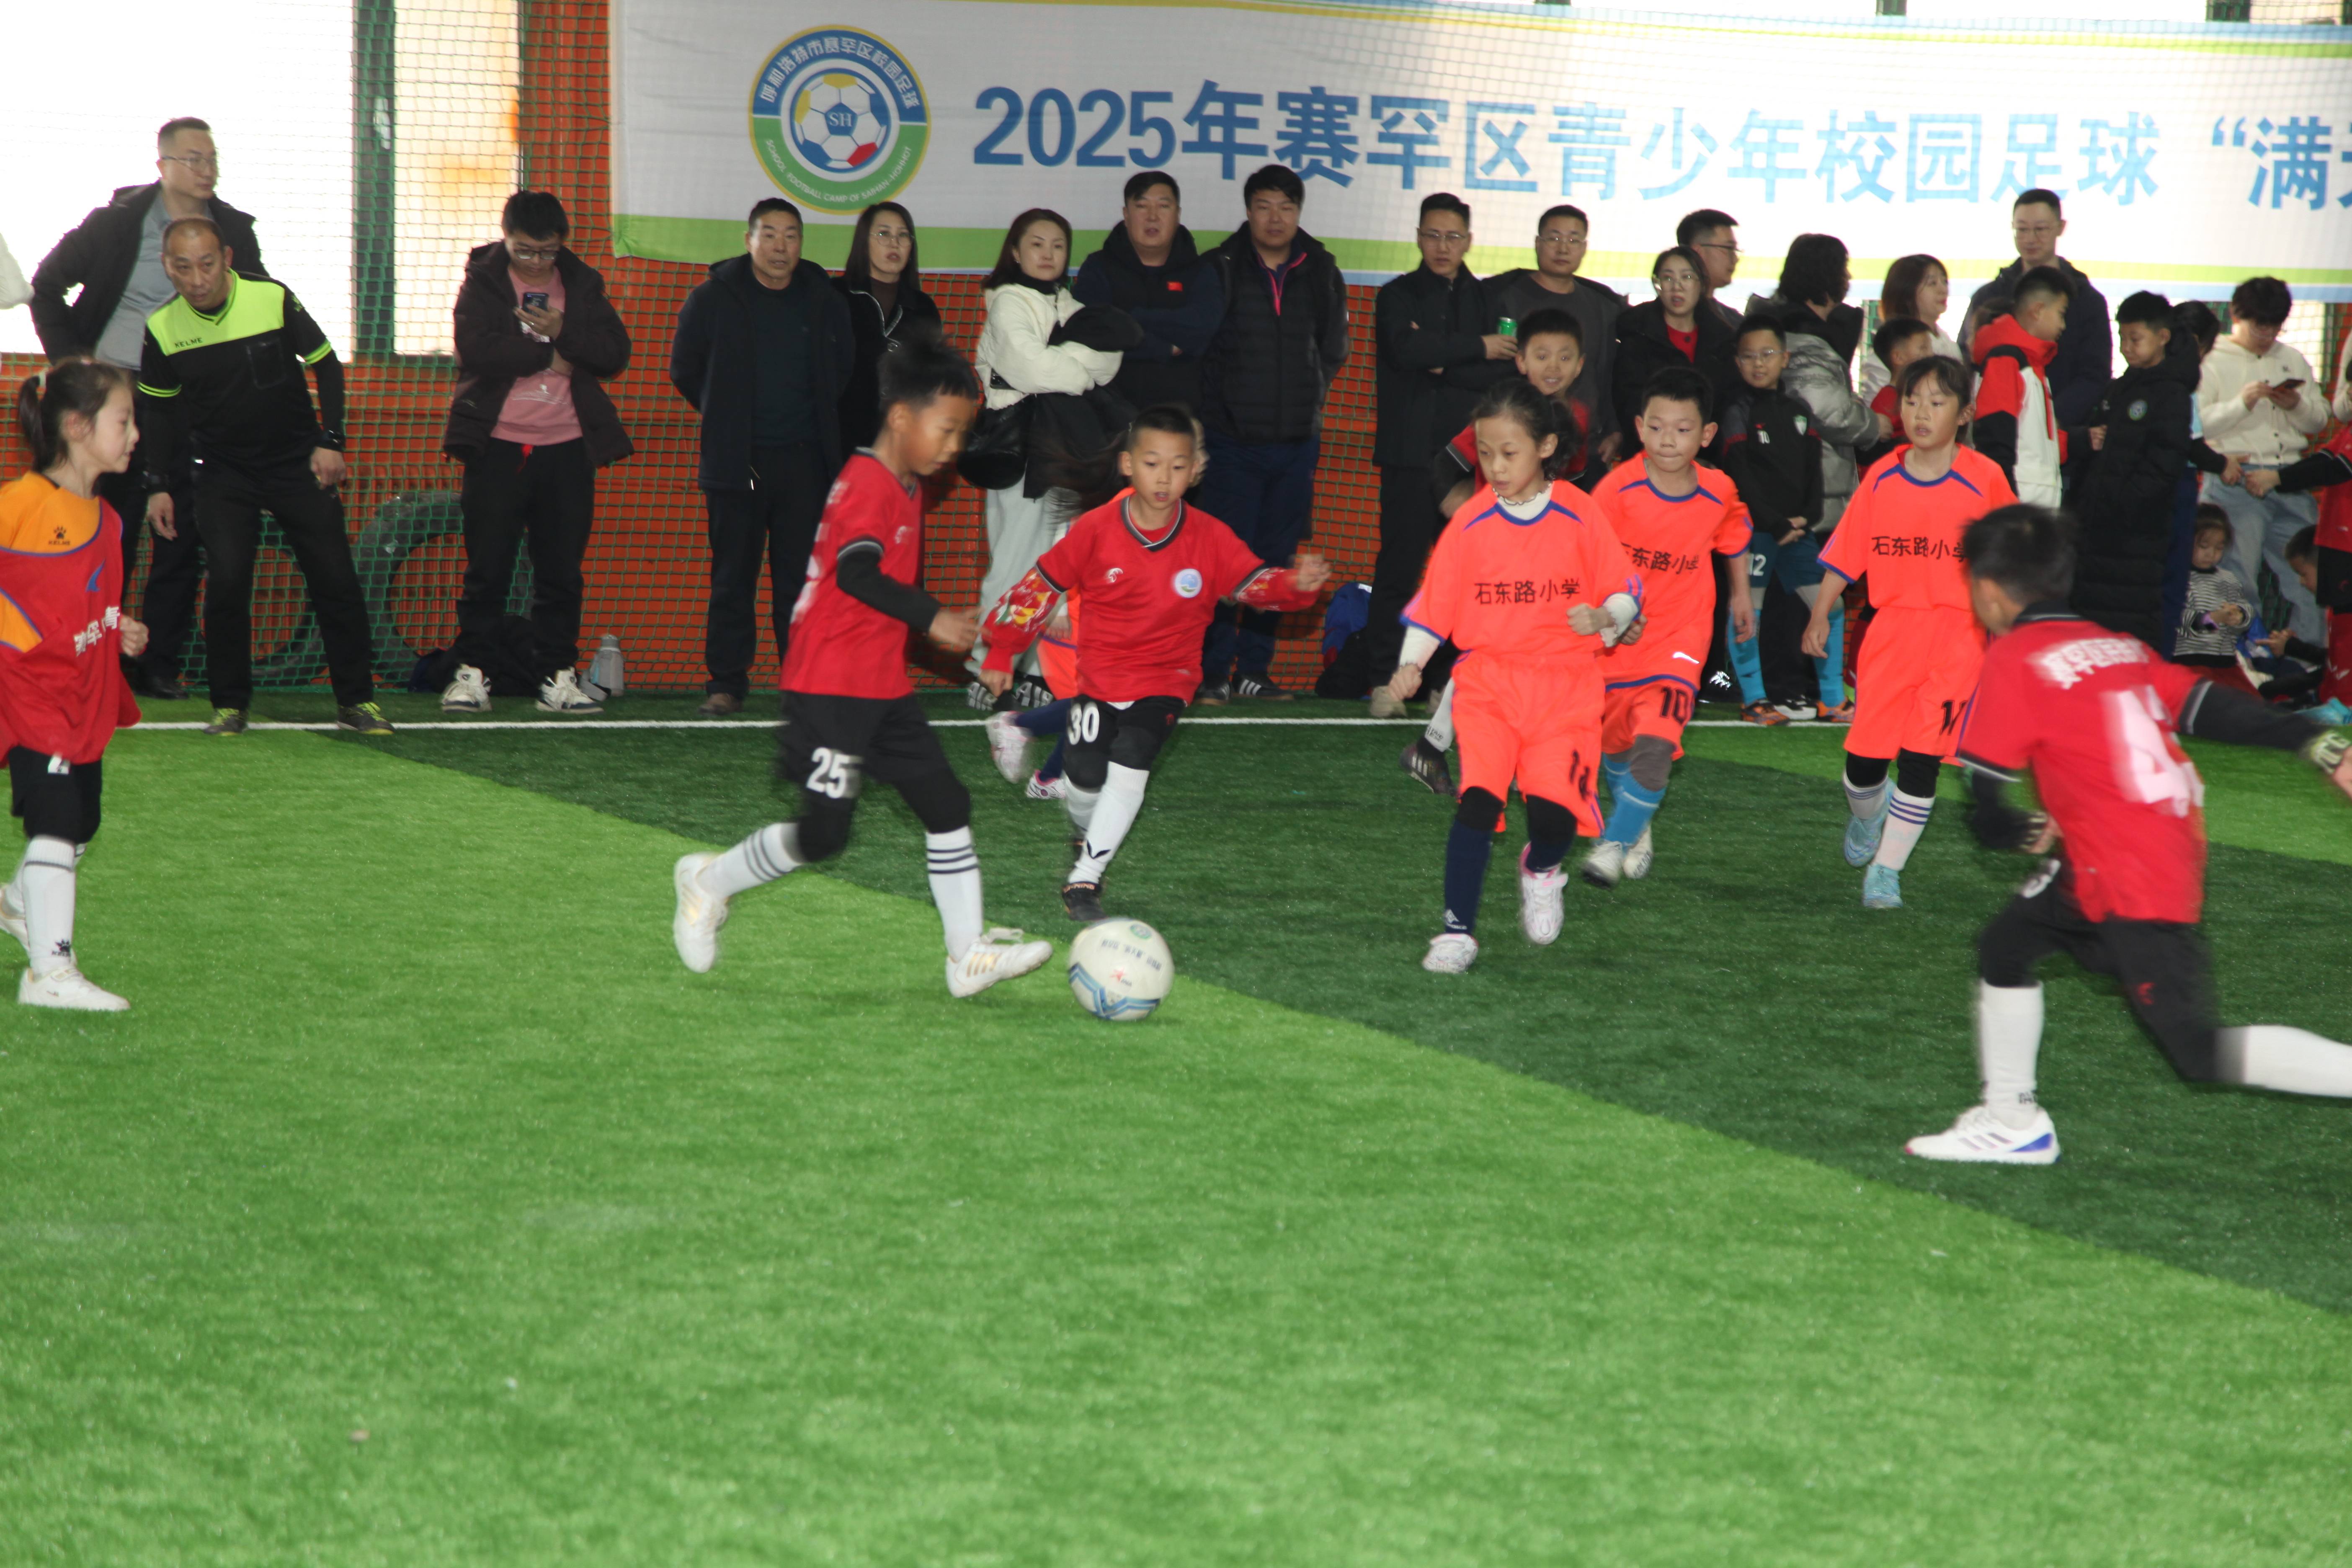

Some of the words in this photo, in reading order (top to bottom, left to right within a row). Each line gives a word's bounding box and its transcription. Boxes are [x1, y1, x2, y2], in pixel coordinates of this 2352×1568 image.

[829, 113, 852, 127] SH
[974, 80, 2352, 210] 2025年赛罕区青少年校园足球“满
[766, 139, 787, 173] SCHOOL
[787, 173, 822, 199] FOOTBALL
[824, 194, 848, 202] CAMP
[850, 193, 860, 202] OF
[174, 338, 204, 348] KELME
[1475, 578, 1581, 605] 石东路小学
[1068, 701, 1100, 745] 30
[1660, 686, 1689, 724] 10
[806, 746, 850, 799] 25
